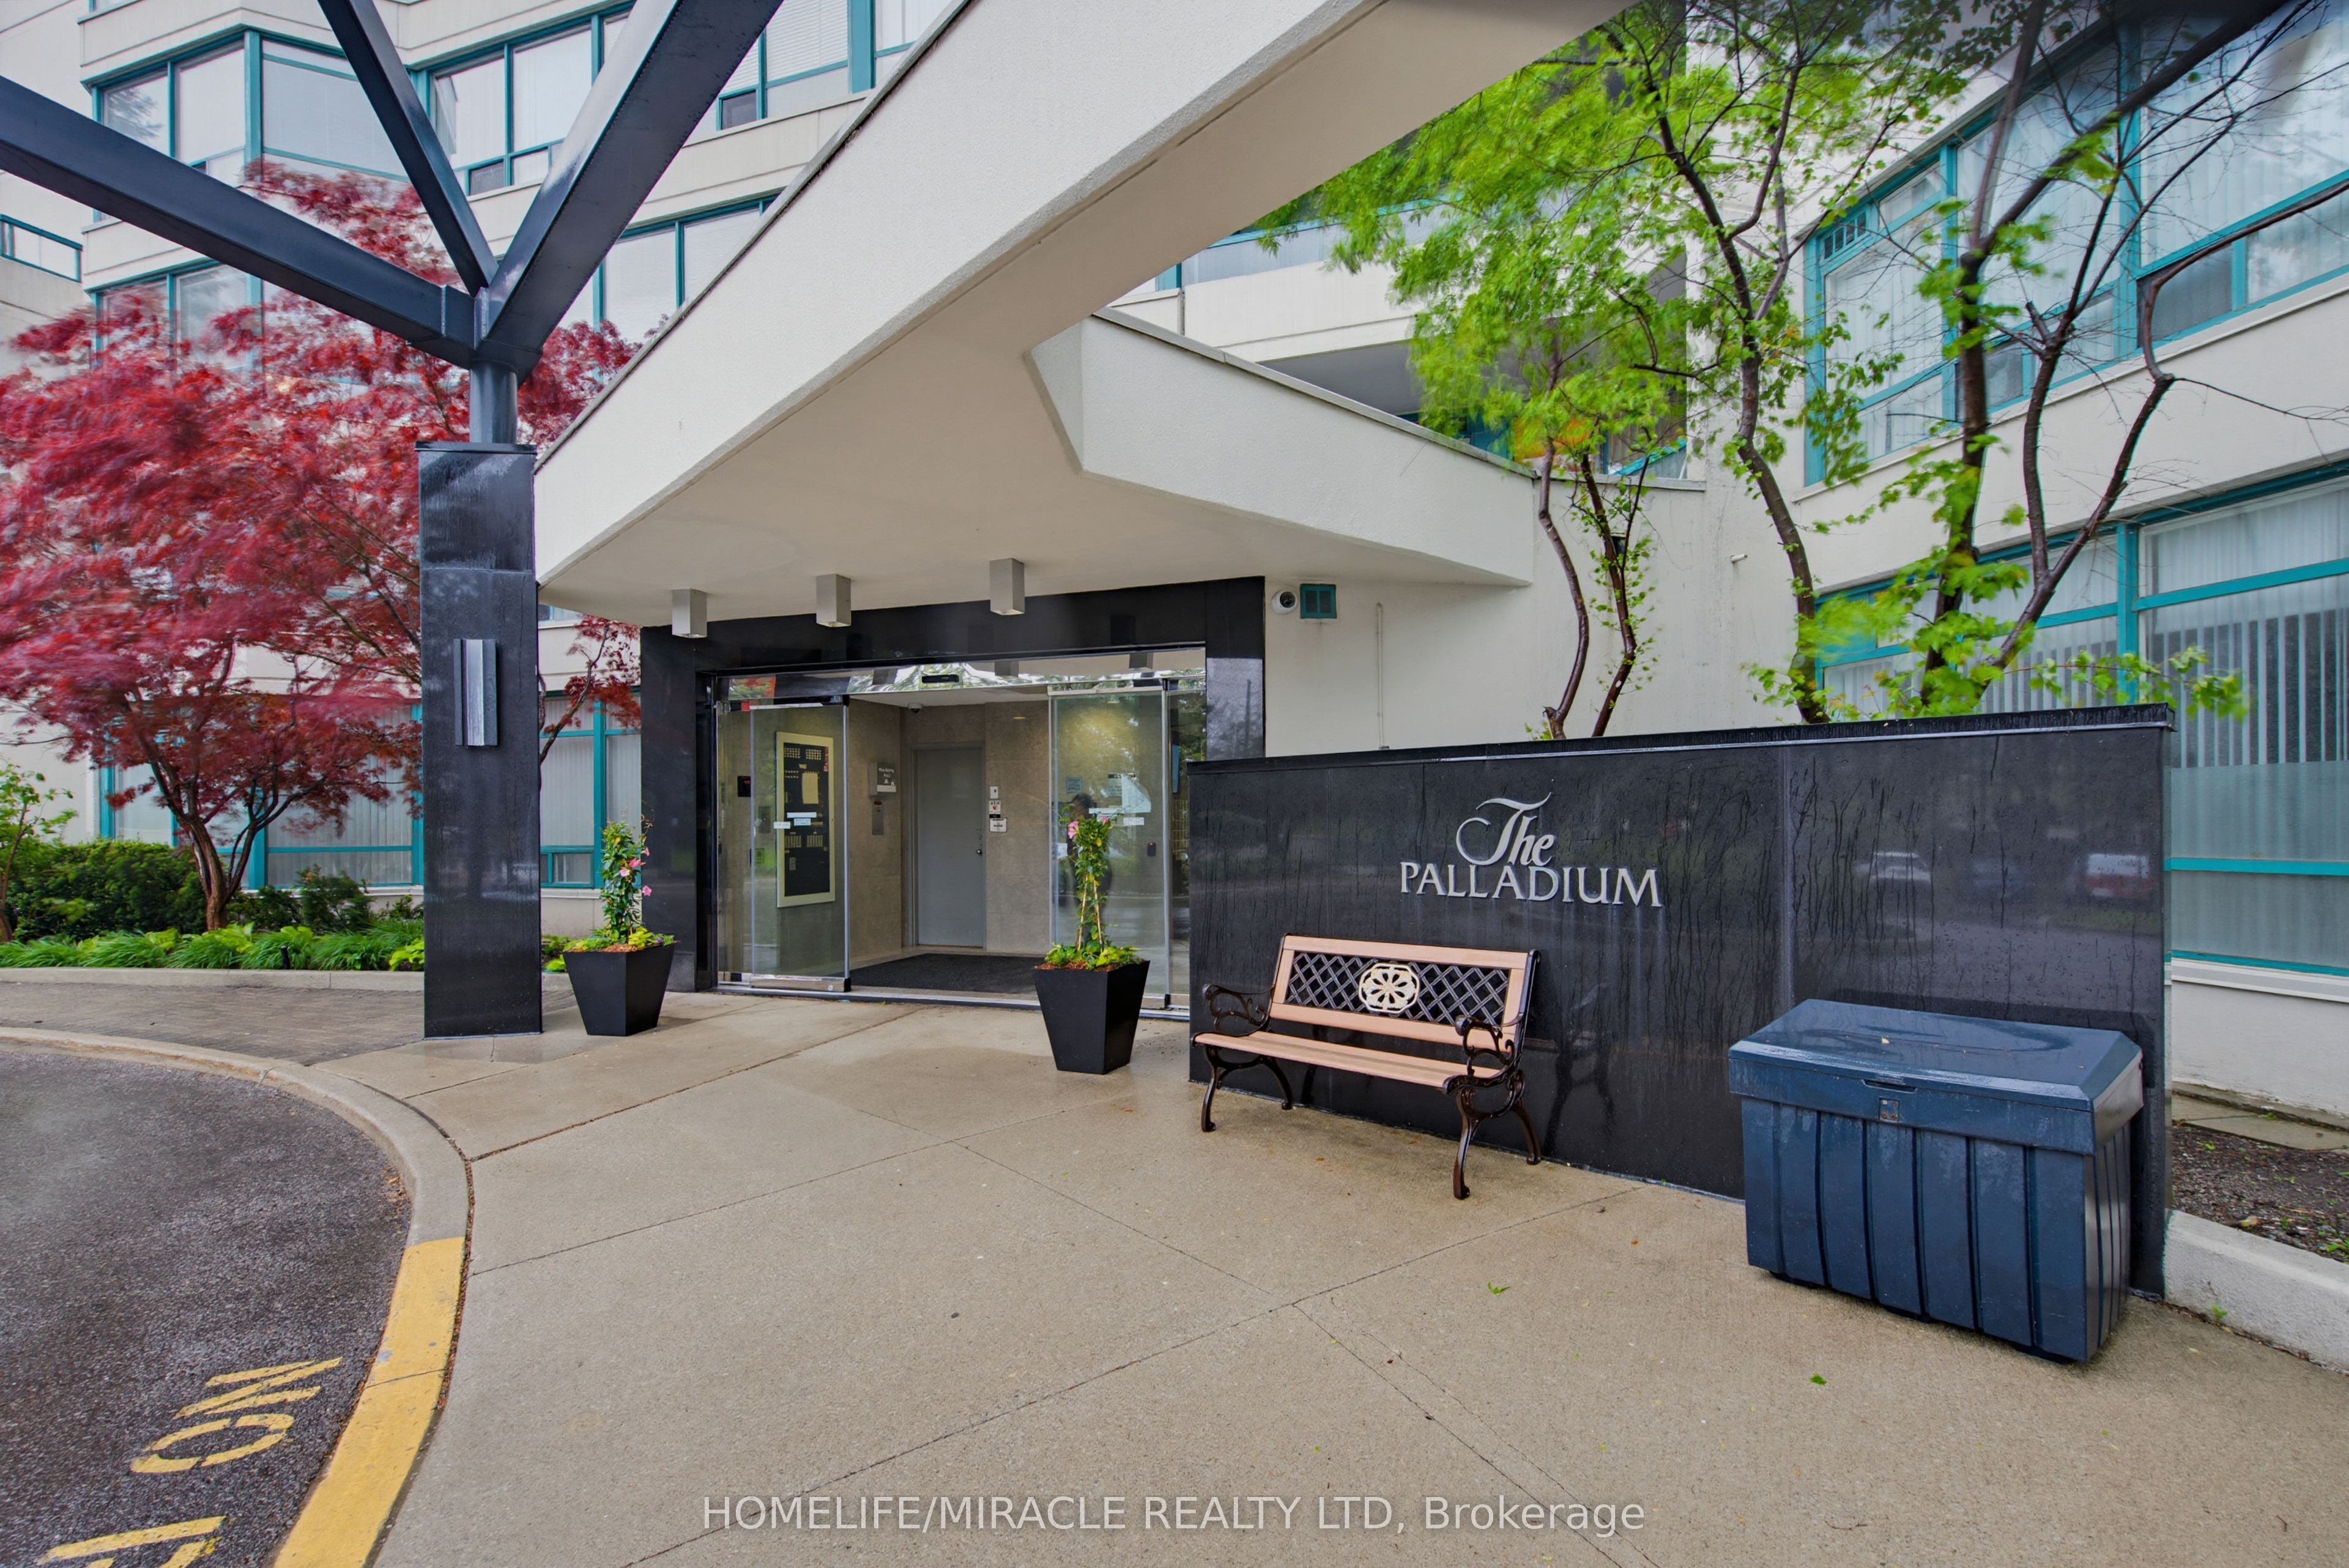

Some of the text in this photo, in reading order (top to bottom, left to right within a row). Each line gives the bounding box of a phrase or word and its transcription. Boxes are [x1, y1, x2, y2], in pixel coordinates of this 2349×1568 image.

[1456, 792, 1554, 867] The
[1400, 861, 1663, 908] PALLADIUM
[130, 1356, 343, 1474] NO
